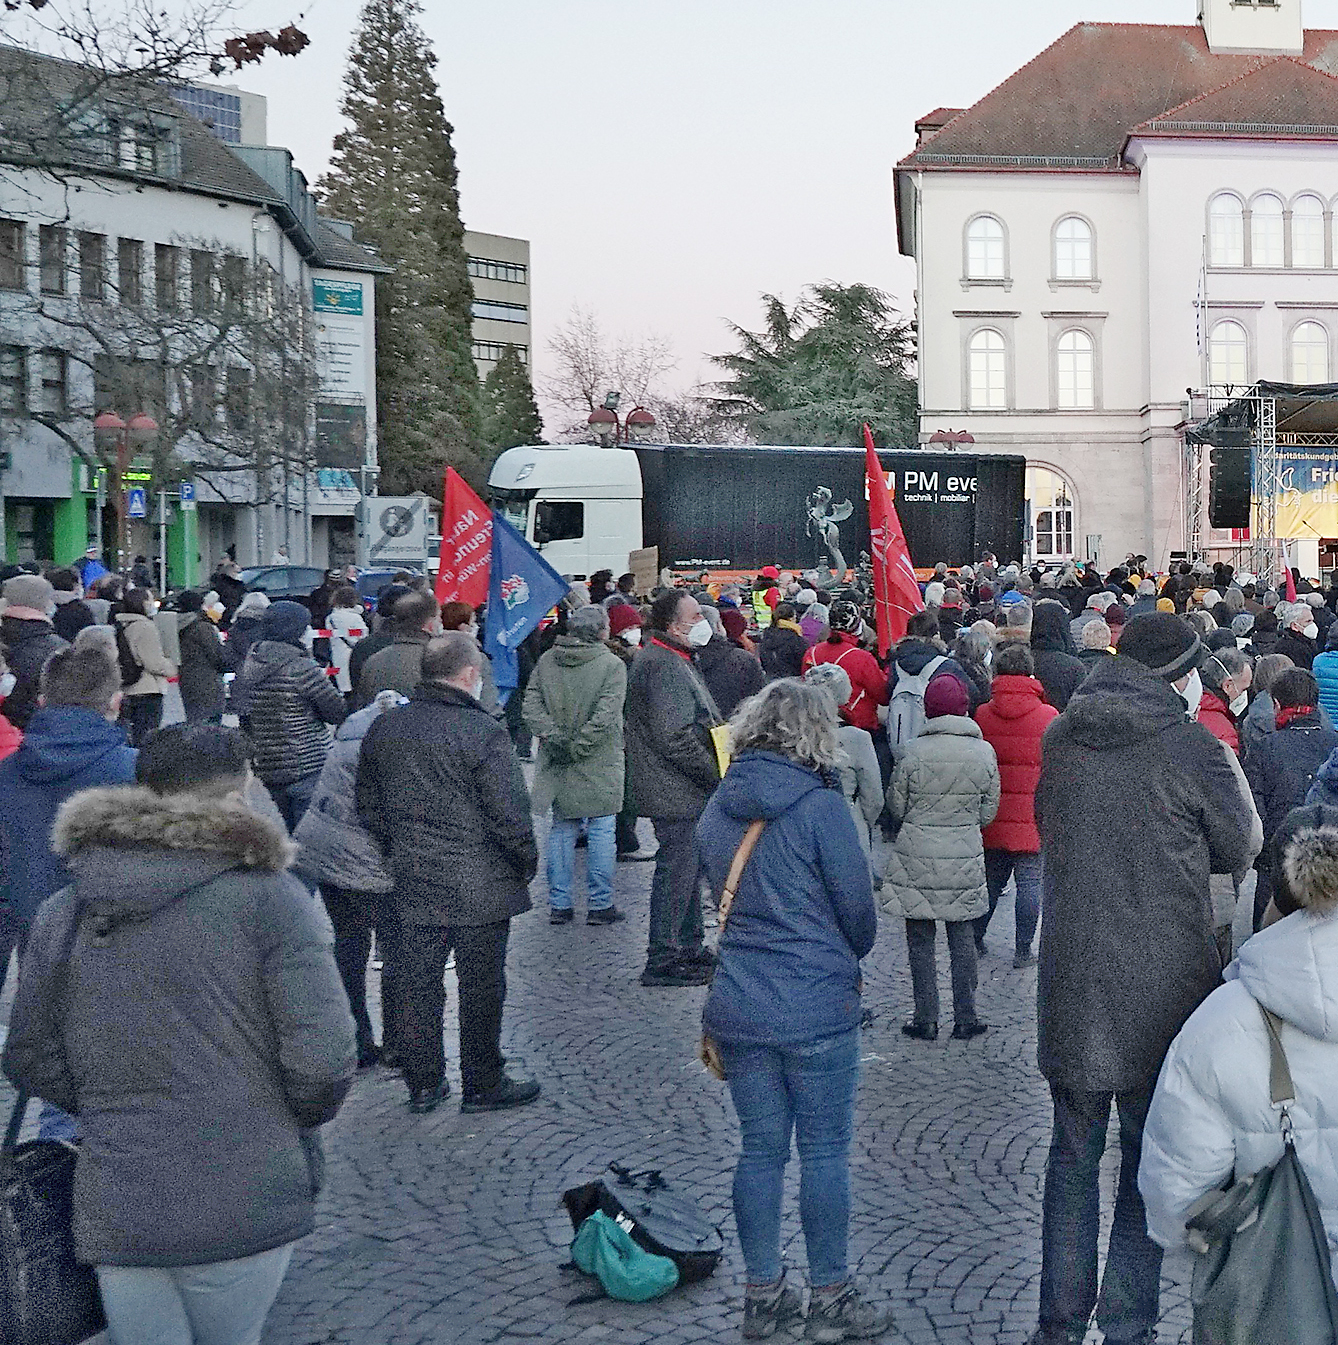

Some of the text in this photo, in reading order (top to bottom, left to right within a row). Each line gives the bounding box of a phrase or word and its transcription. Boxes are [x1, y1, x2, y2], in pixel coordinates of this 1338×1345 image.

[904, 471, 939, 491] PM
[904, 493, 971, 502] technik mobiliar
[1313, 489, 1338, 504] die
